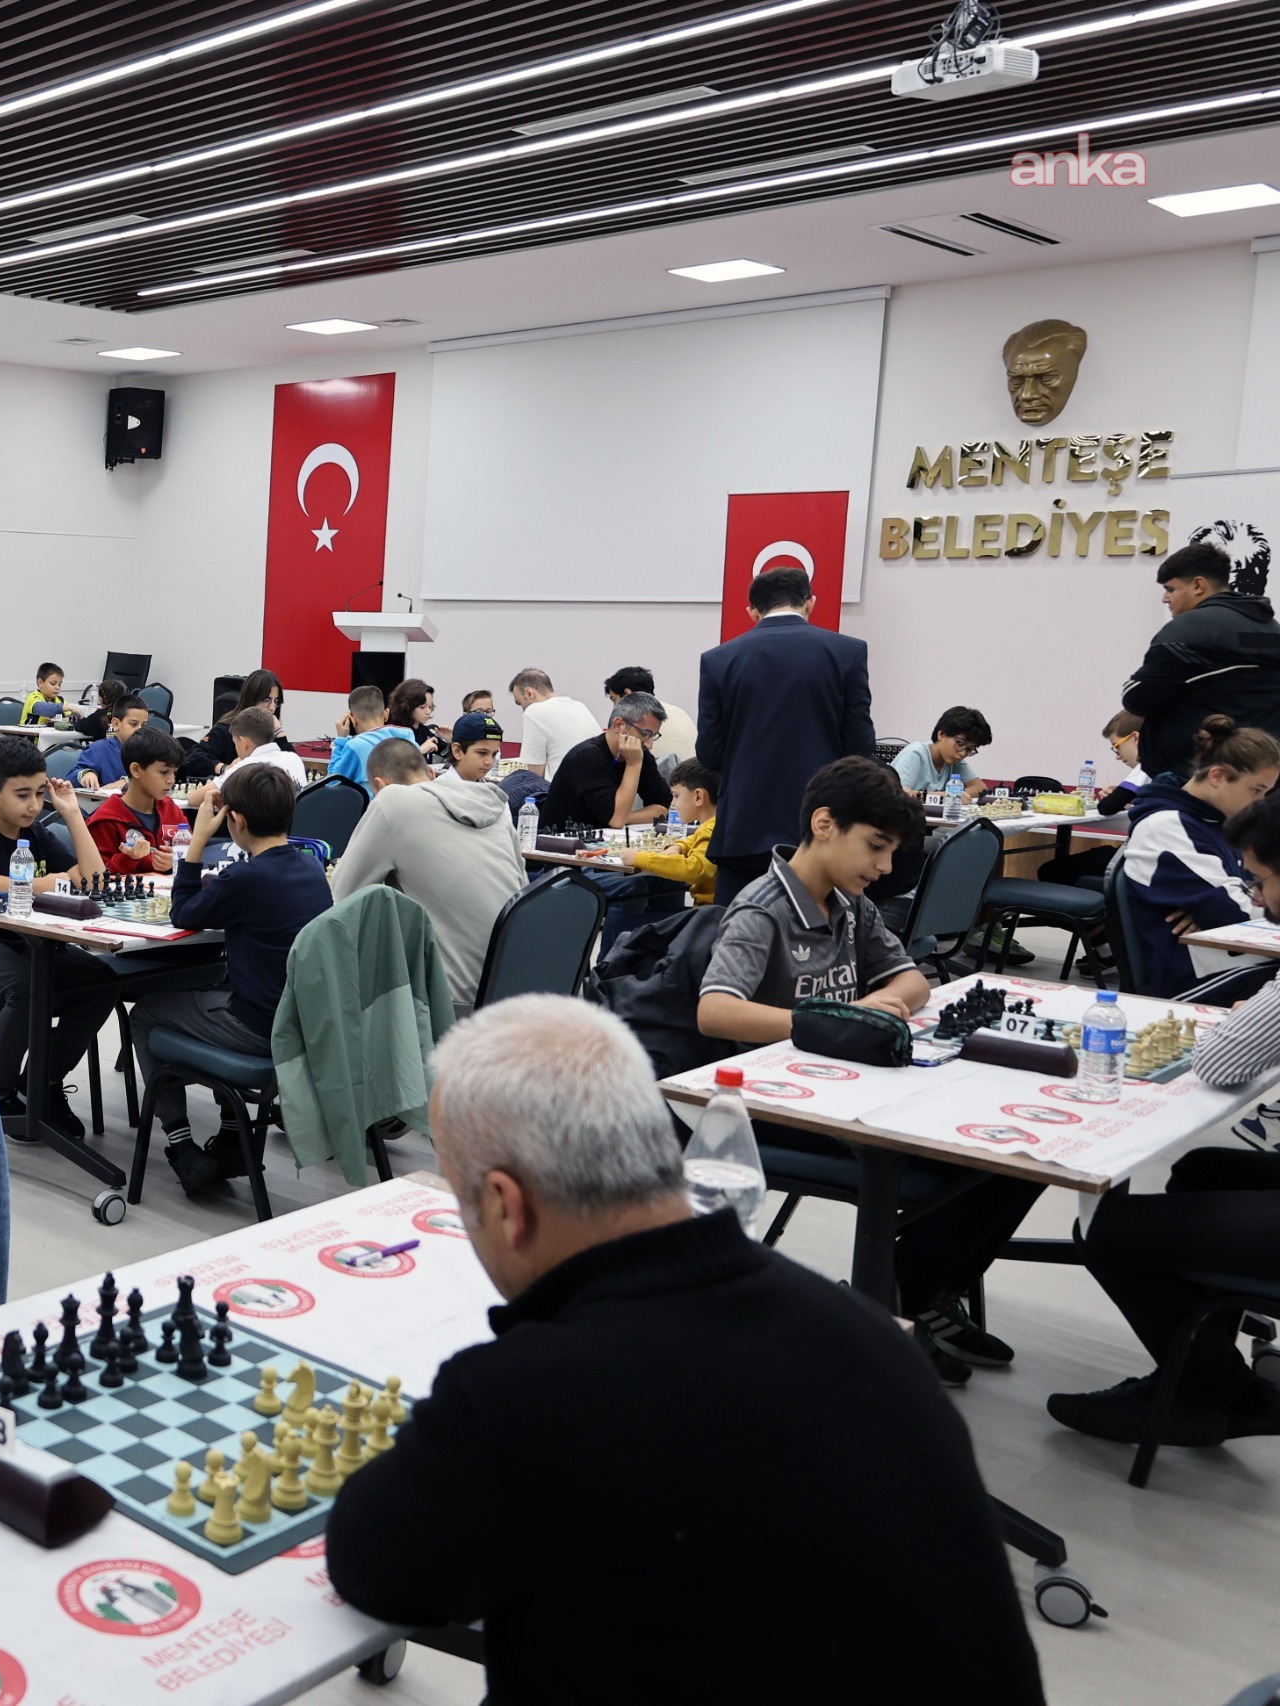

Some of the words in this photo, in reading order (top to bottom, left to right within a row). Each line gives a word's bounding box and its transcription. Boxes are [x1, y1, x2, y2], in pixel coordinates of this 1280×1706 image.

[906, 431, 1174, 496] MENTEŞE
[879, 498, 1170, 560] BELEDİYES
[928, 796, 938, 804] 10
[57, 882, 67, 893] 14
[1006, 1018, 1029, 1034] 07
[141, 1607, 258, 1669] MENTEŞE
